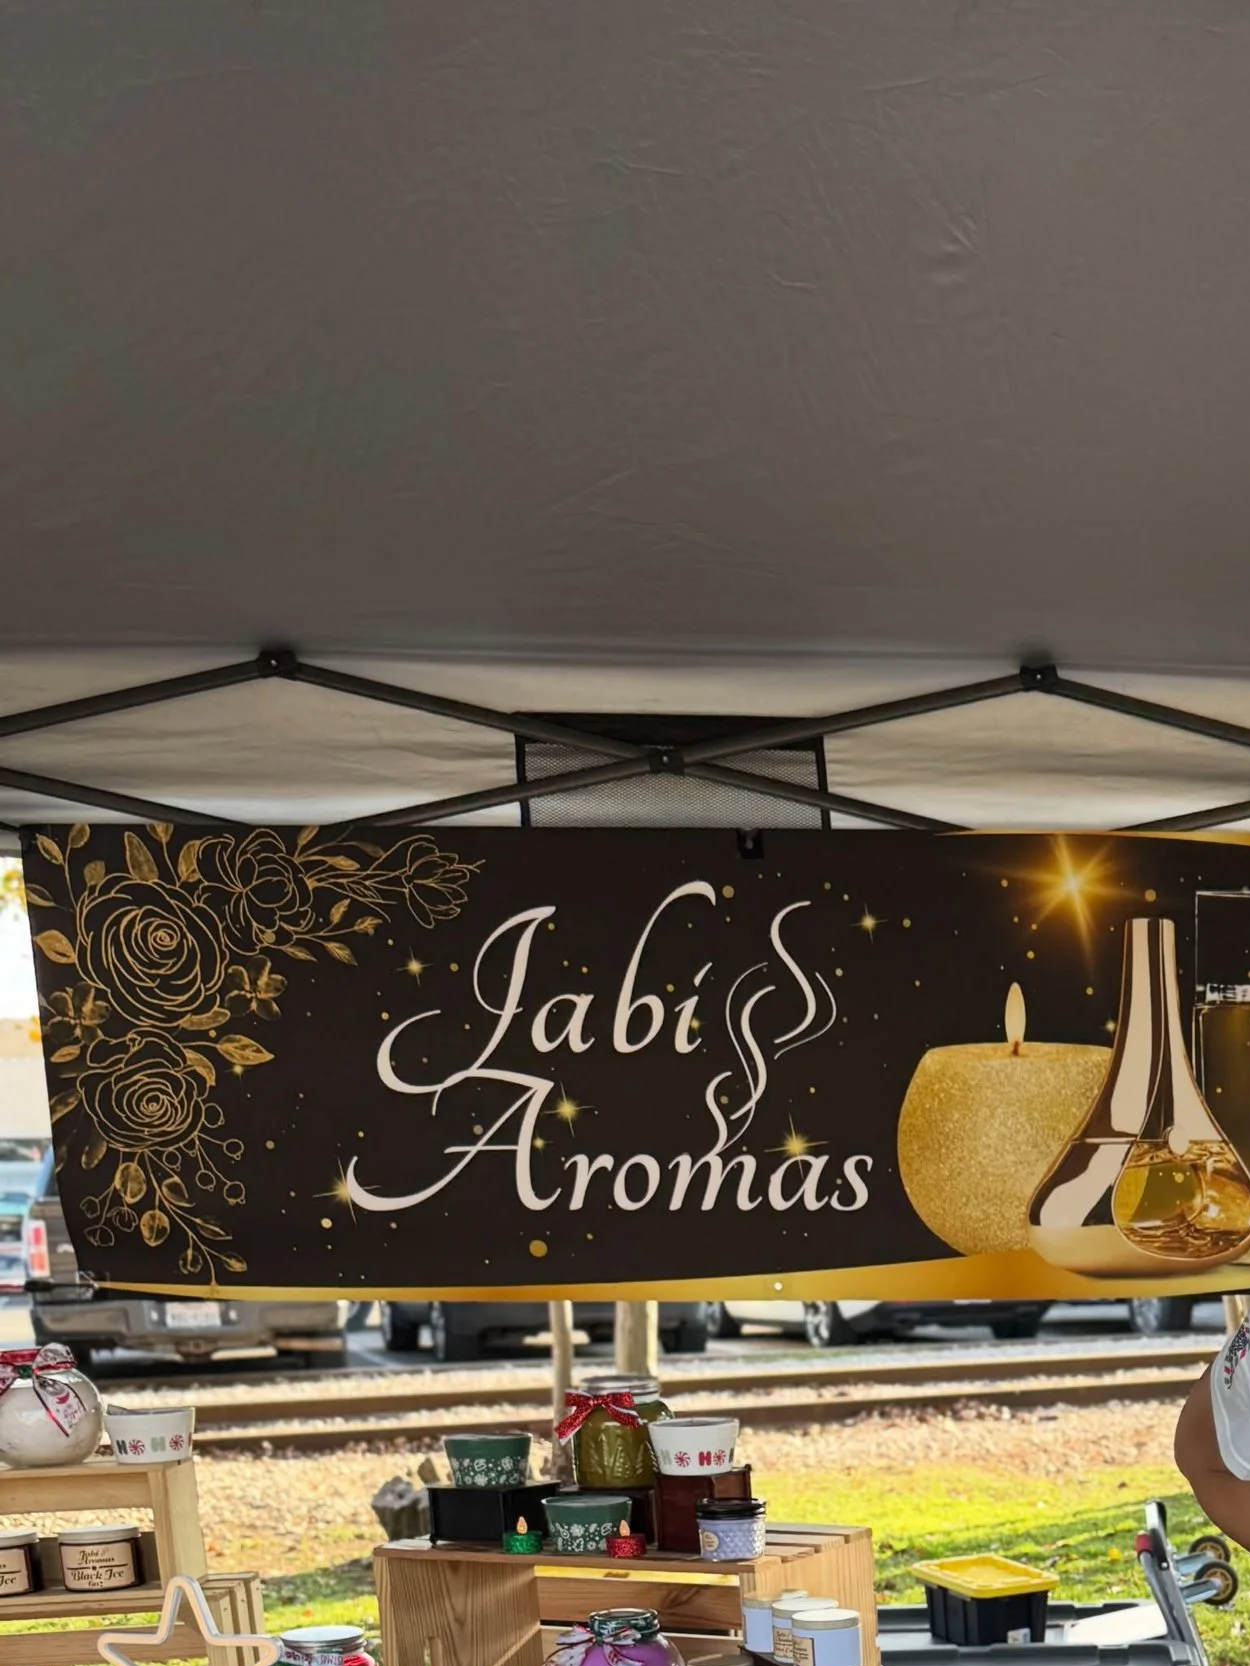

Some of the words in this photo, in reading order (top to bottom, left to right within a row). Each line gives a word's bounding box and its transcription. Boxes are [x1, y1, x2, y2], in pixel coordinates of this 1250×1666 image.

[347, 1068, 873, 1212] Aromas
[71, 1570, 102, 1581] Black
[104, 1569, 124, 1580] Ice
